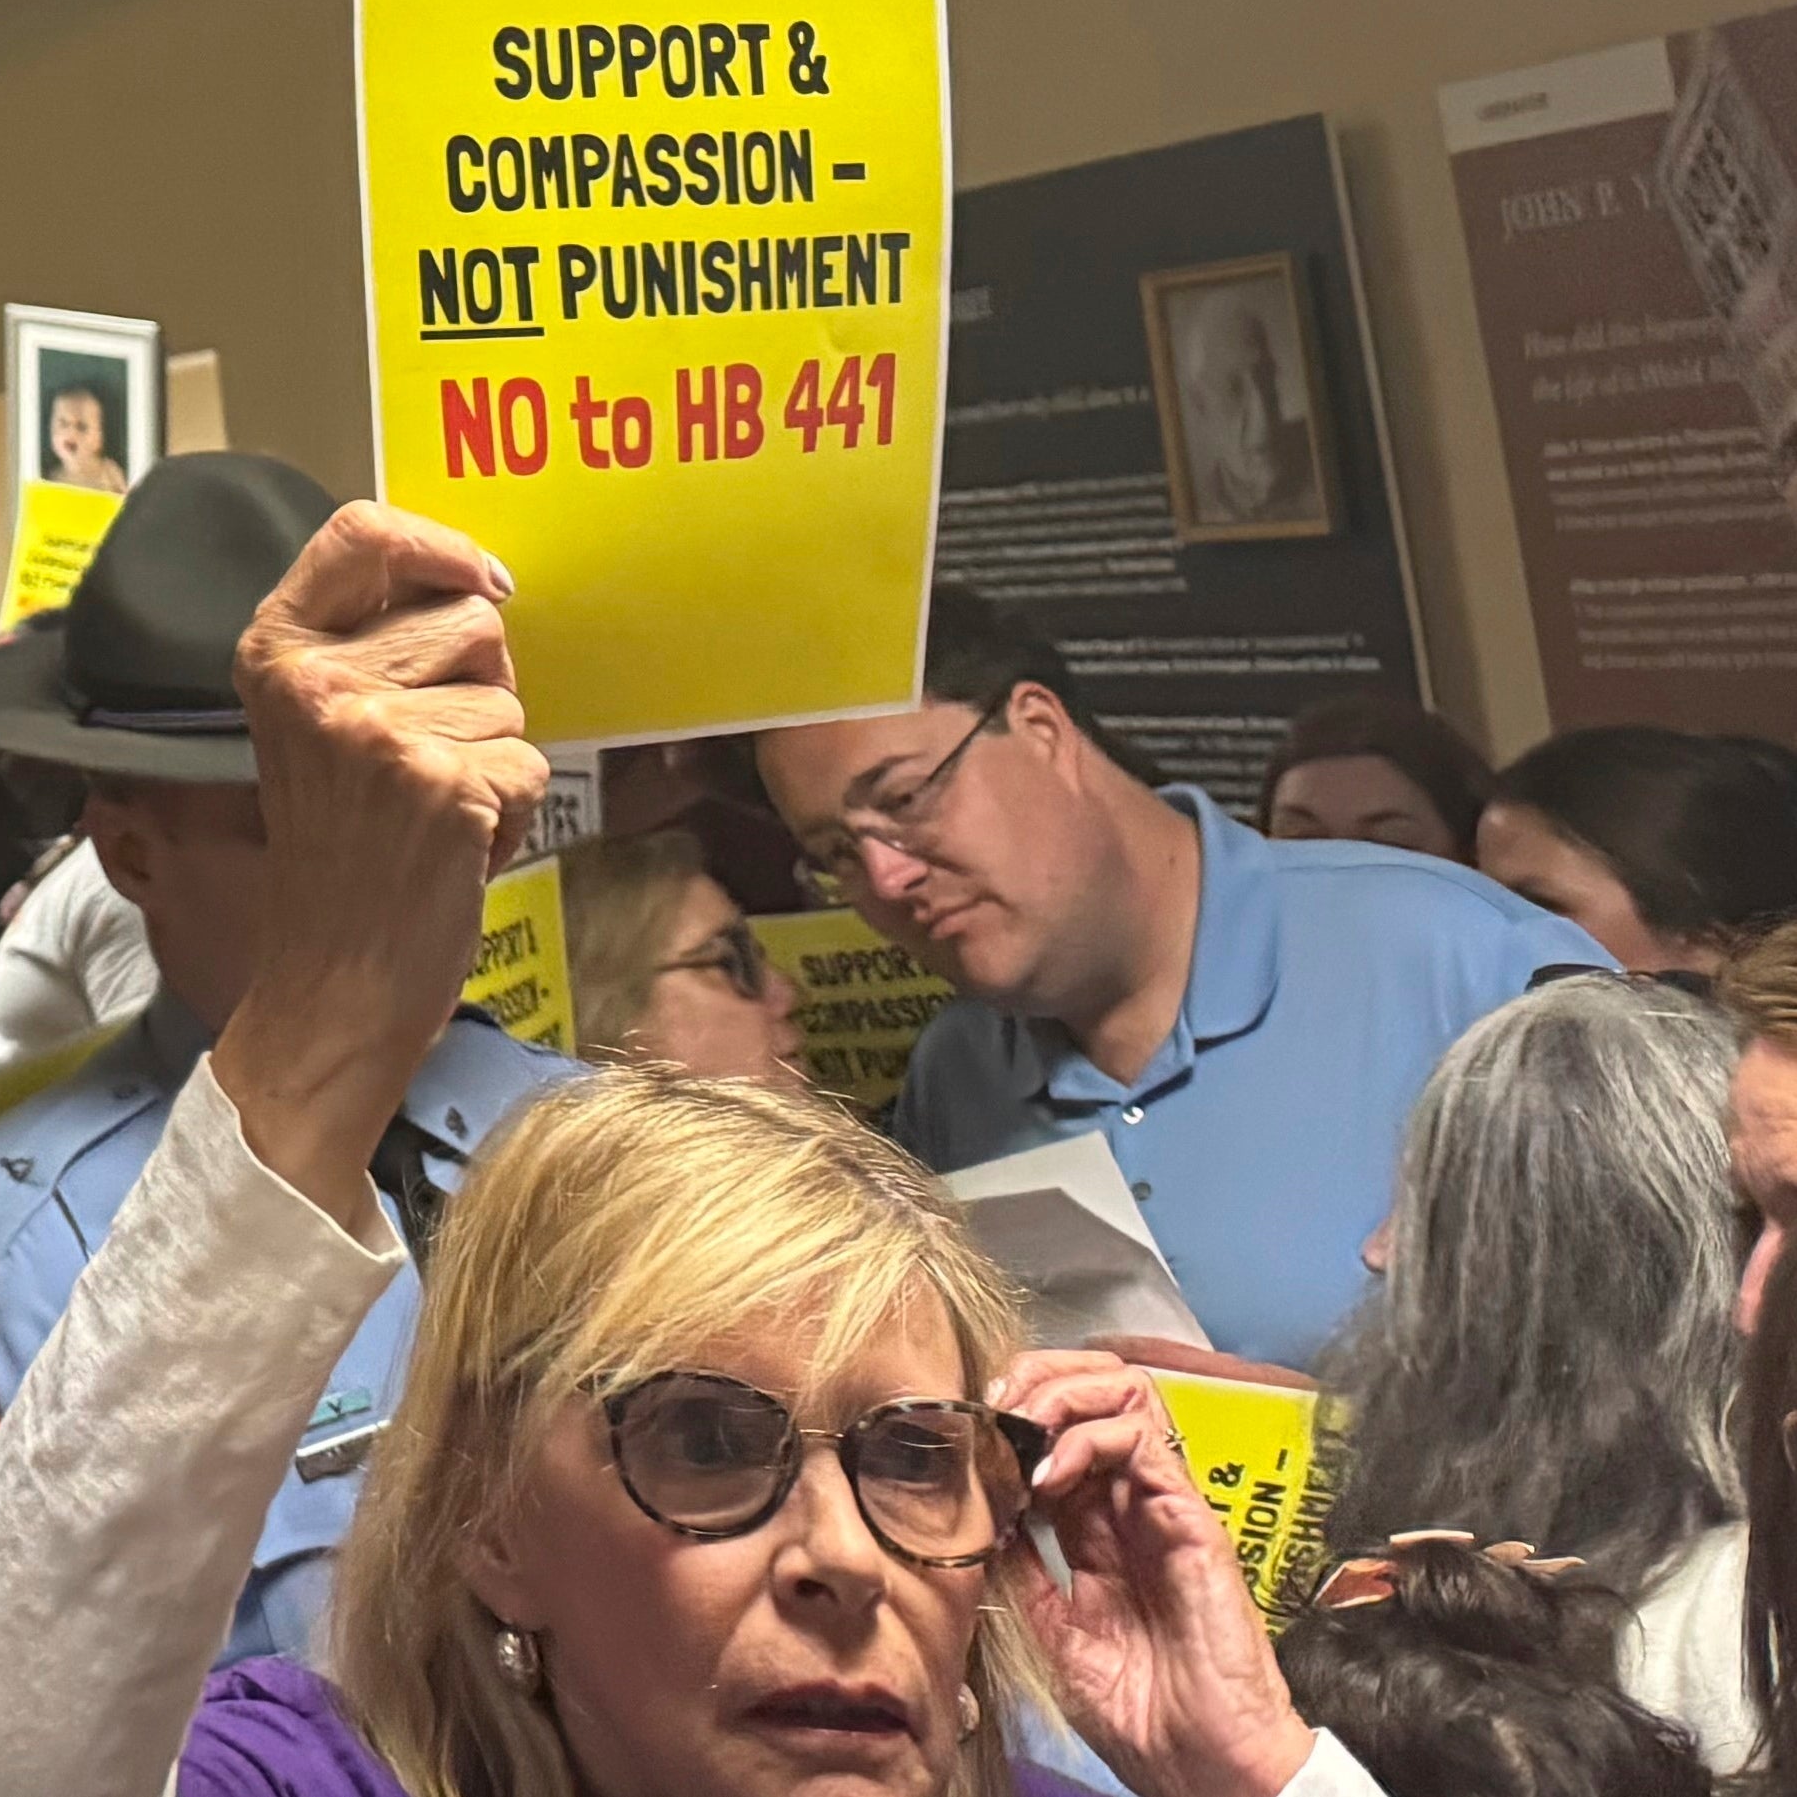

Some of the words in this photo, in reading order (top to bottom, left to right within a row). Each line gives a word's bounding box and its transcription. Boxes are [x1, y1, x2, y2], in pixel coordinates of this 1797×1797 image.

[493, 24, 771, 101] SUPPORT
[788, 20, 829, 95] &
[446, 128, 812, 213] COMPASSION
[419, 246, 542, 327] NOT
[560, 232, 911, 320] PUNISHMENT
[441, 372, 547, 479] NO
[570, 375, 654, 470] to
[675, 362, 764, 463] HB
[784, 352, 897, 454] 441
